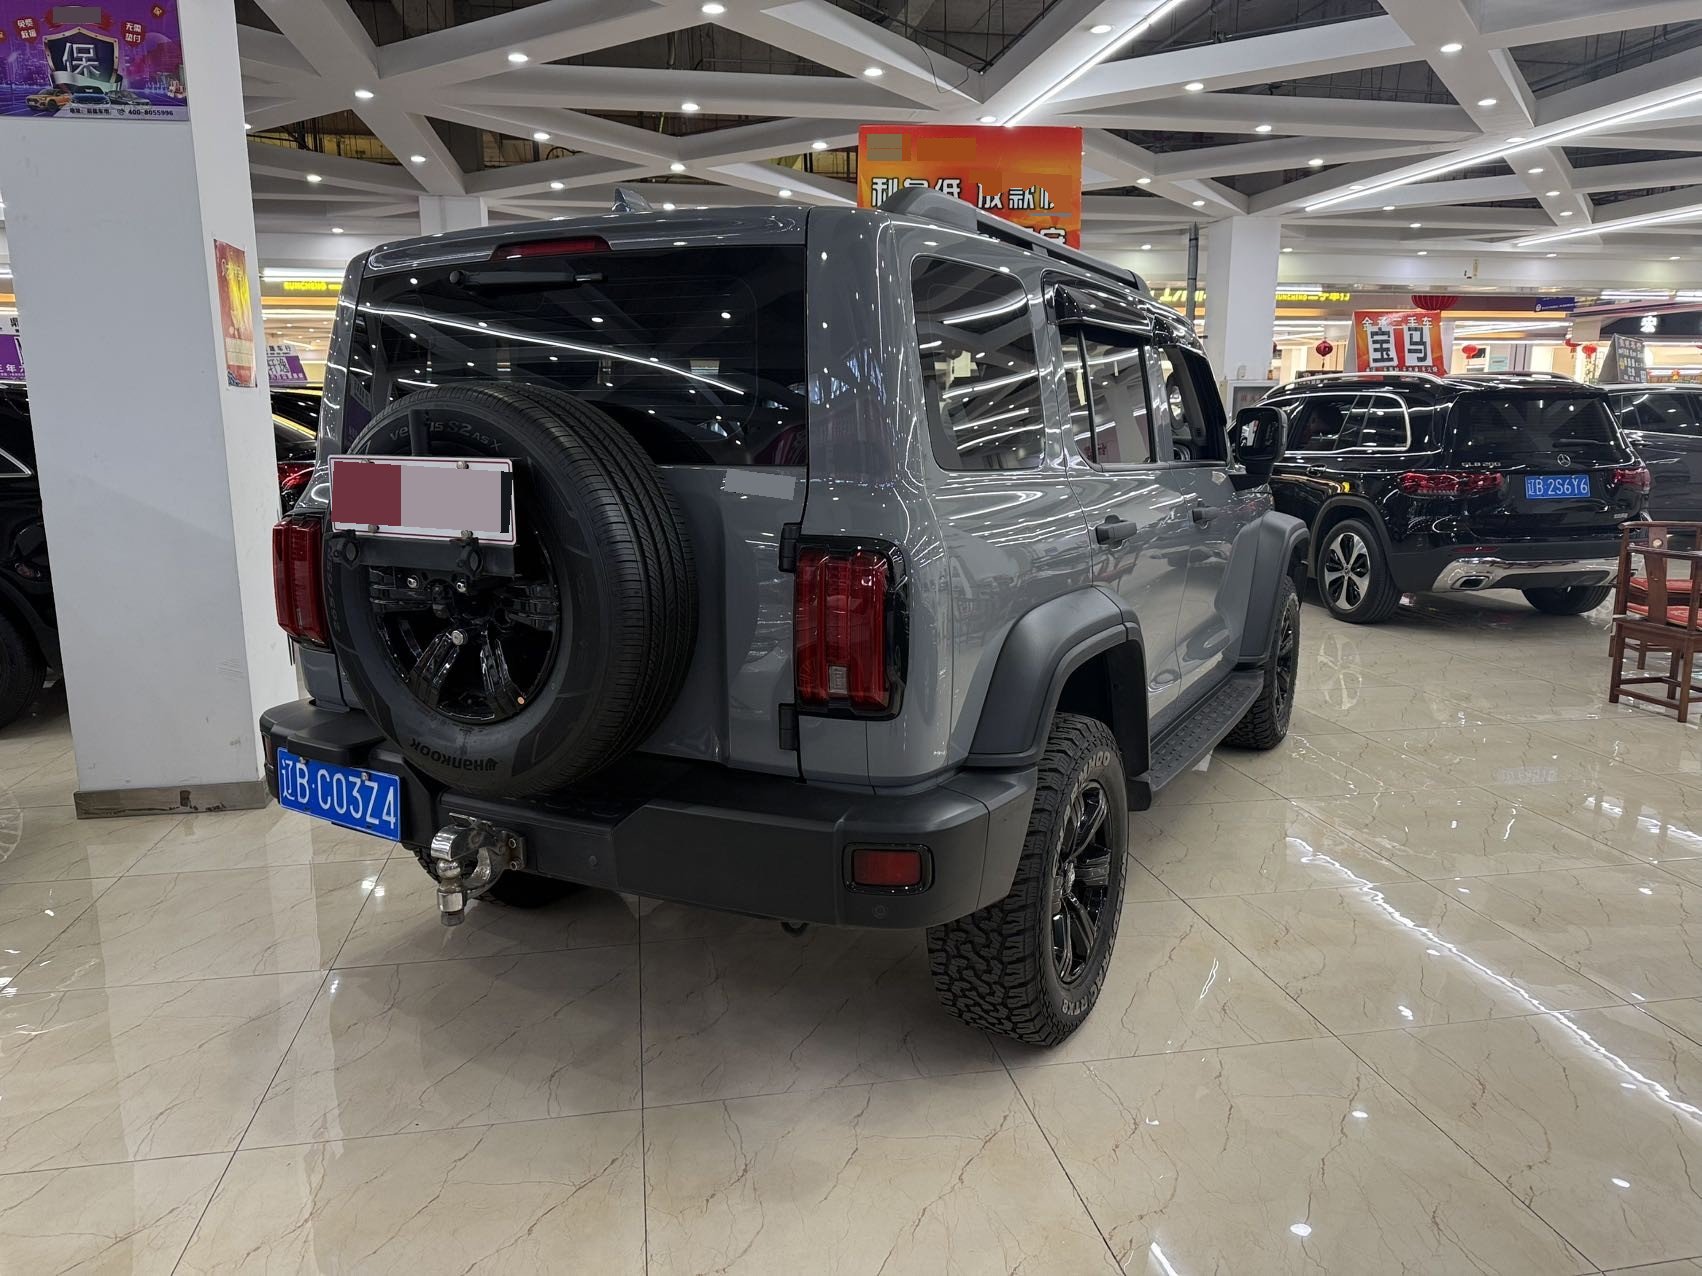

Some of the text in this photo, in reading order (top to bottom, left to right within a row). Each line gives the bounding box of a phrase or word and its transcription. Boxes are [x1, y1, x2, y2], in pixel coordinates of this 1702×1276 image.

[63, 42, 100, 76] 保
[1370, 327, 1428, 363] 宝马
[281, 758, 397, 829] 辽B·C03Z4
